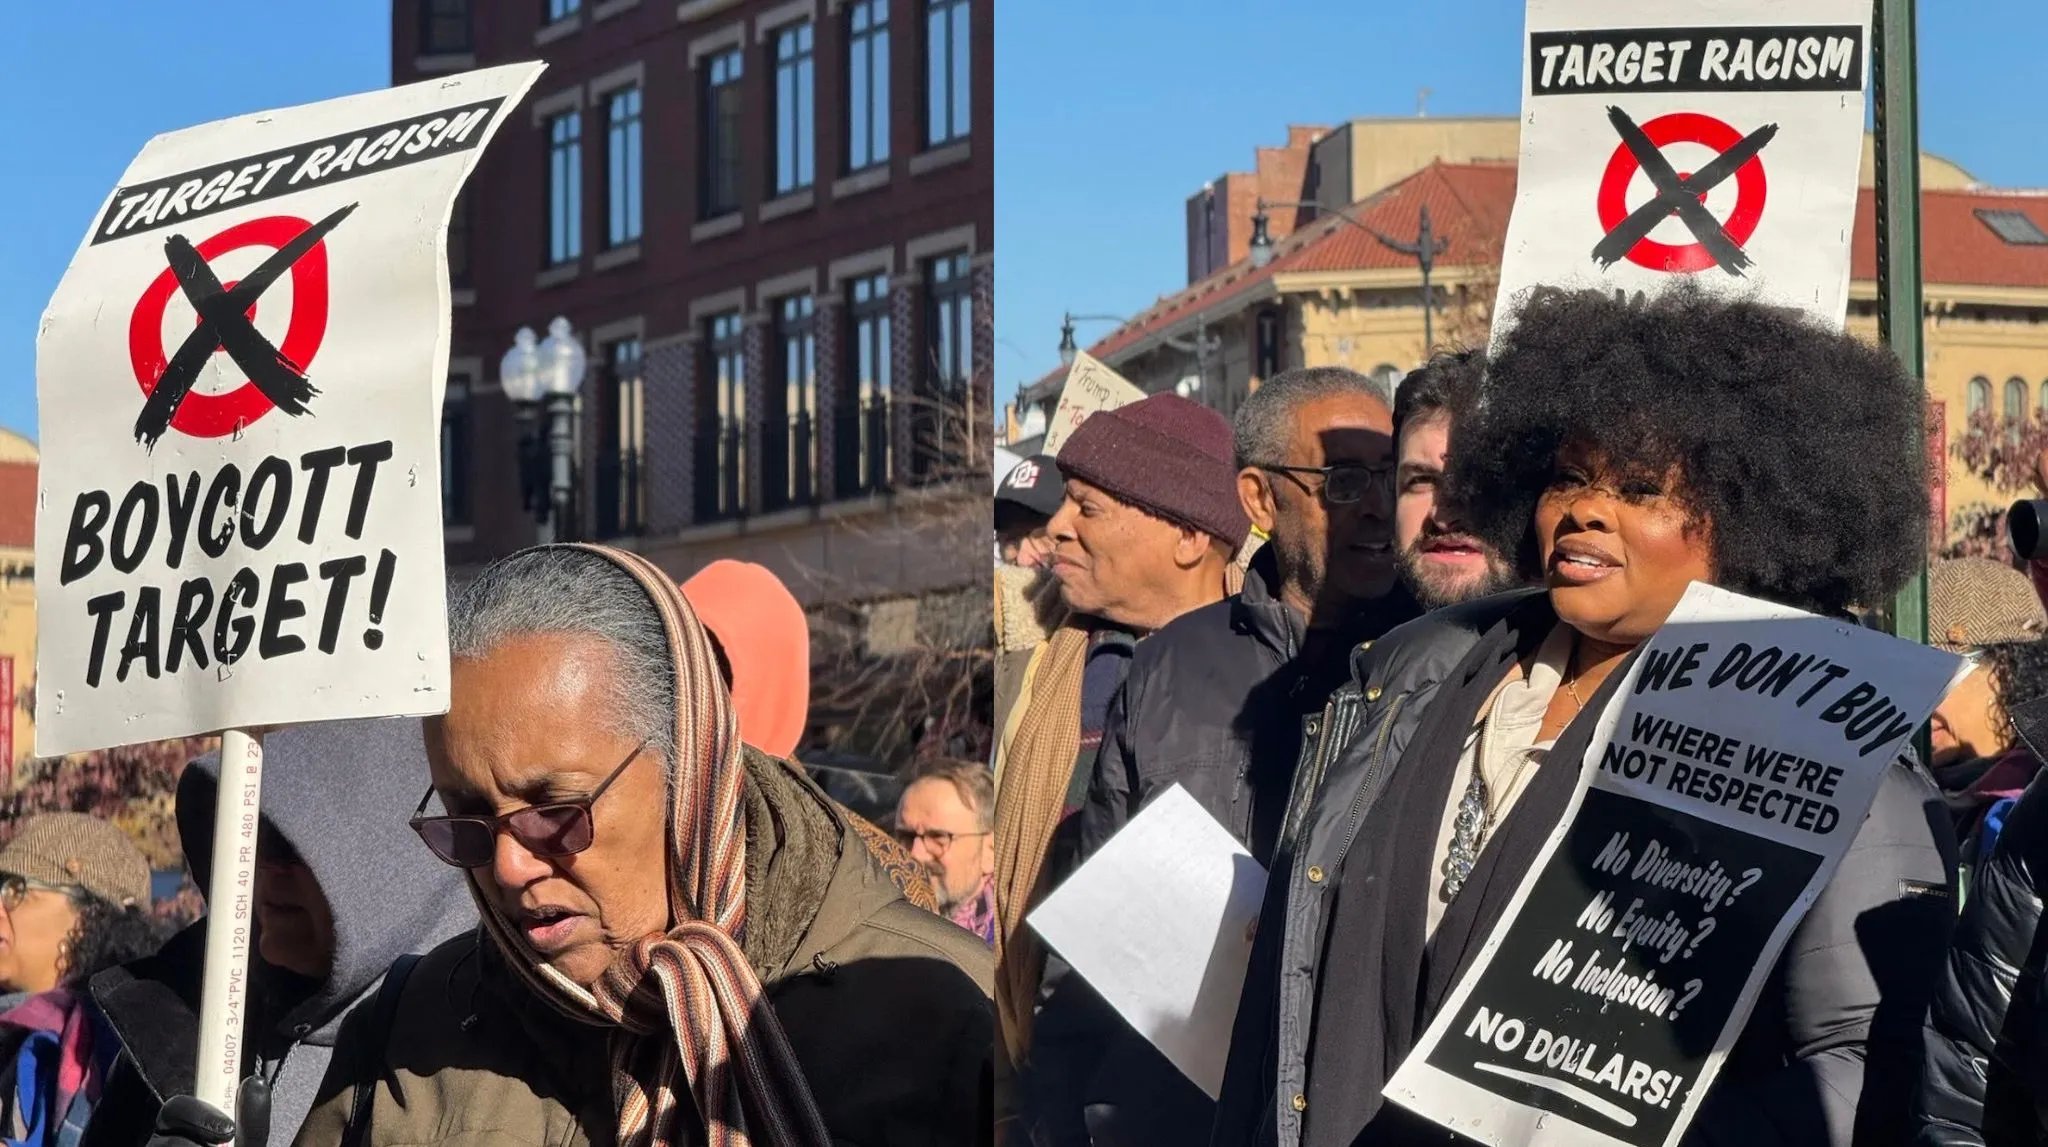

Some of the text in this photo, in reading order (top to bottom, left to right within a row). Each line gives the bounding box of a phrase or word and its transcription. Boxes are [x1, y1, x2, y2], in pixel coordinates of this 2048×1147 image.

[1541, 36, 1854, 87] TARGET RACISM
[106, 108, 477, 235] TARGET RACISM
[61, 441, 392, 585] BOYCOTT
[87, 549, 396, 687] TARGET!
[1634, 642, 1912, 757] WE DON'T BUY
[1599, 743, 1840, 835] NOT RESPECTED
[1631, 712, 1845, 798] WHERE WE'RE
[241, 813, 254, 839] 480
[243, 783, 256, 807] PSI
[237, 870, 249, 888] 40
[239, 845, 252, 863] PR
[1593, 832, 1762, 912] No Diversity?
[232, 926, 246, 960] 1120
[235, 894, 248, 920] SCH
[1576, 890, 1716, 963] No Equity?
[1532, 938, 1703, 1021] No Inclusion?
[223, 1033, 237, 1075] 04007
[1464, 1006, 1684, 1109] NO DOLLARS!
